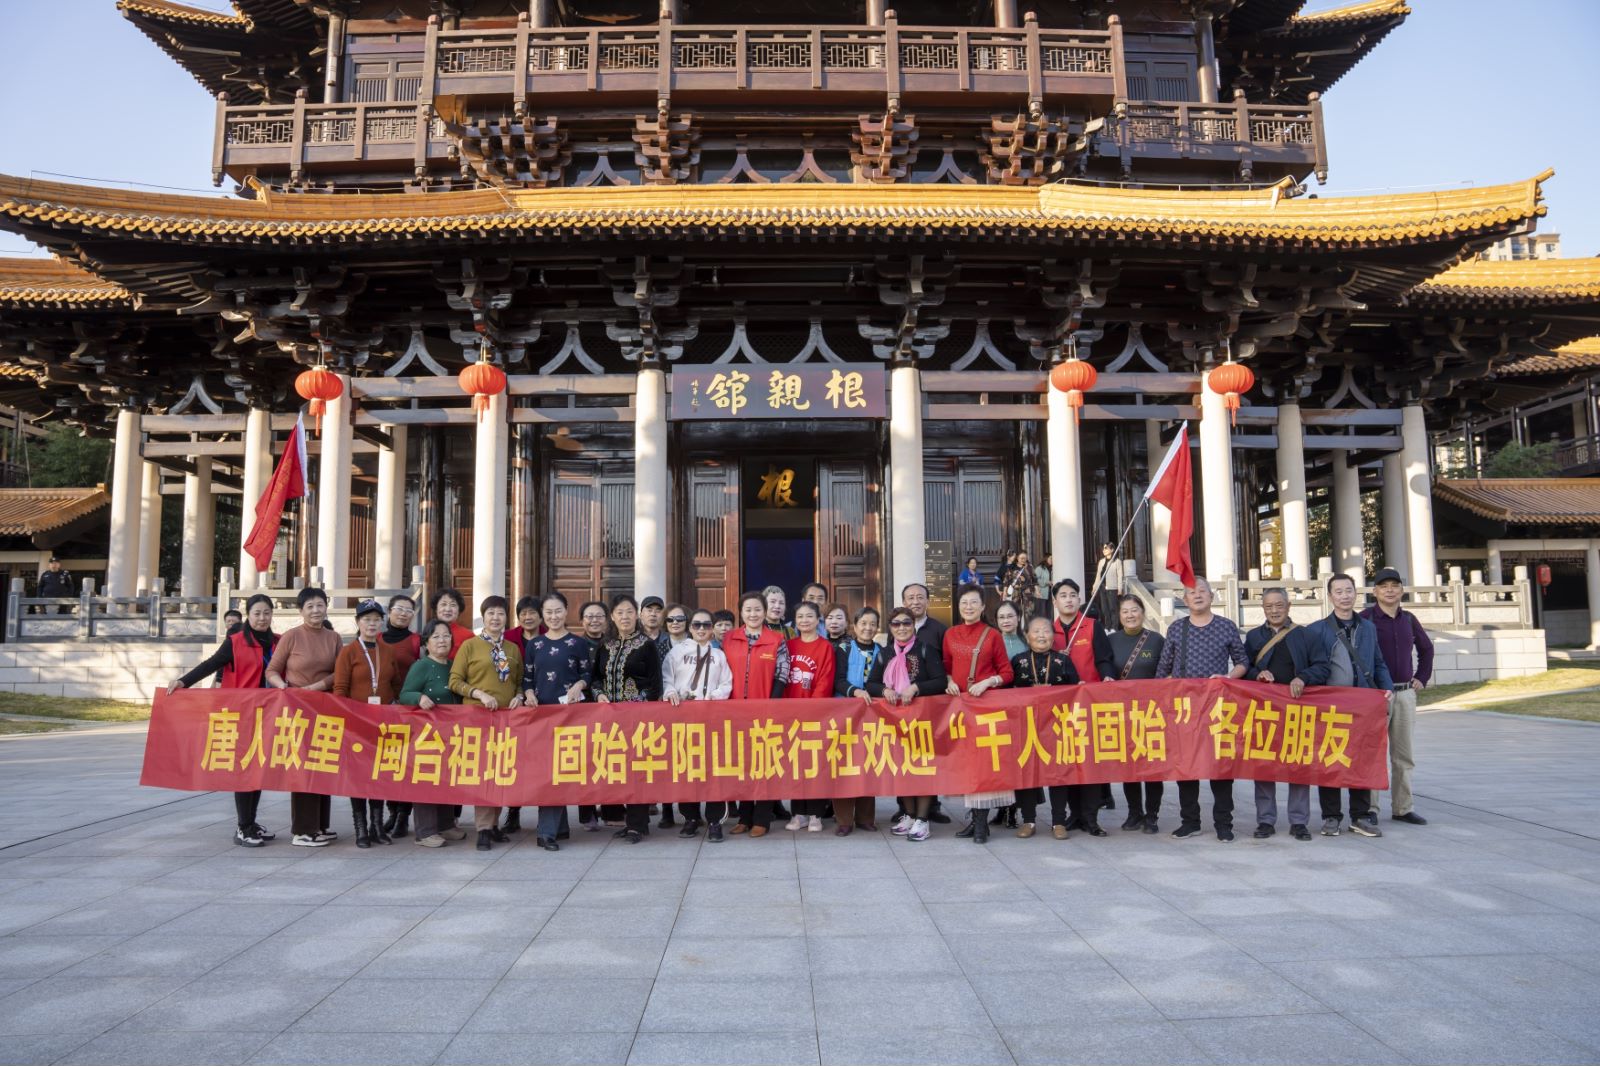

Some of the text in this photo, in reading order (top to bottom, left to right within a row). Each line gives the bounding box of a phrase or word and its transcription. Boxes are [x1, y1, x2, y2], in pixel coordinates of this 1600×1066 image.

[200, 706, 517, 786] 唐人故里·闽台祖地
